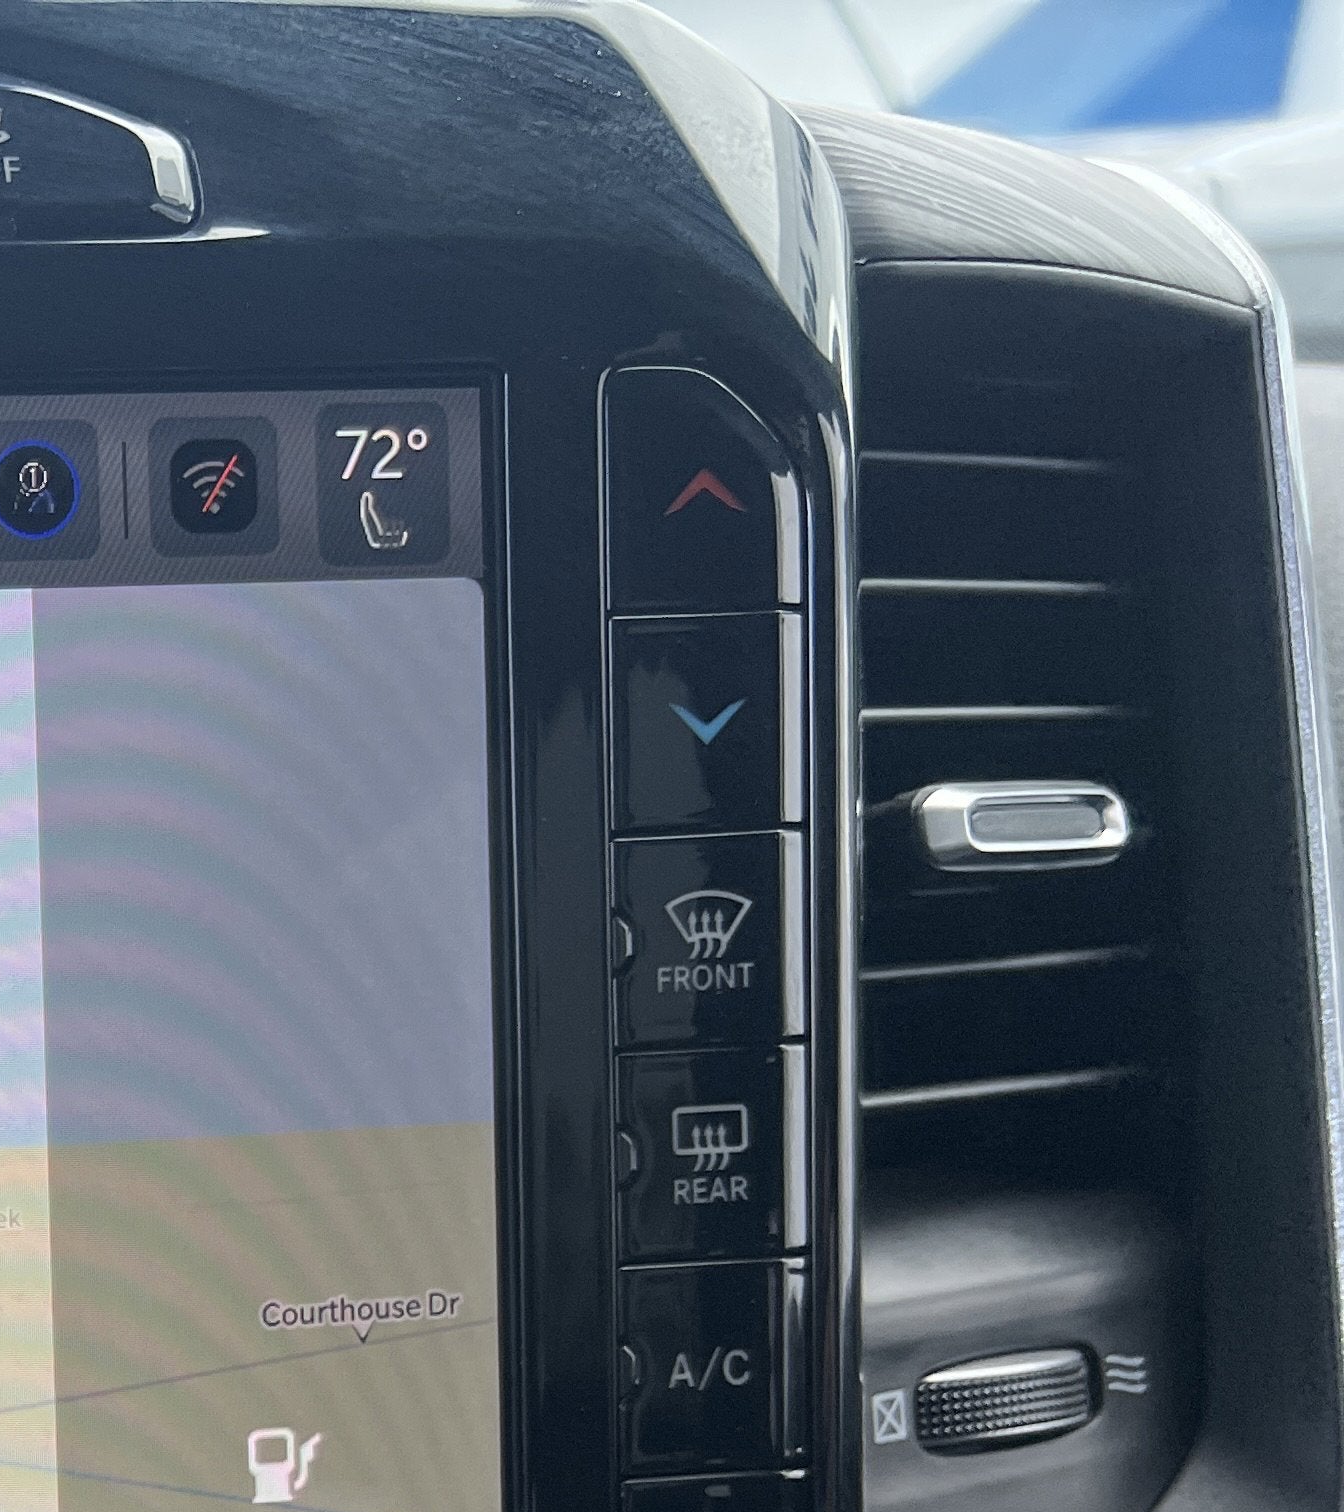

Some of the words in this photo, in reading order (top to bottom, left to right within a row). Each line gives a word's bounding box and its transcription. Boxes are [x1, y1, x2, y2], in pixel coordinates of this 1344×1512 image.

[335, 428, 428, 480] 72°
[657, 961, 755, 993] FRONT
[673, 1176, 749, 1205] REAR
[261, 1296, 421, 1328] Courthouse
[427, 1292, 461, 1317] Dr
[668, 1346, 751, 1388] A/C
